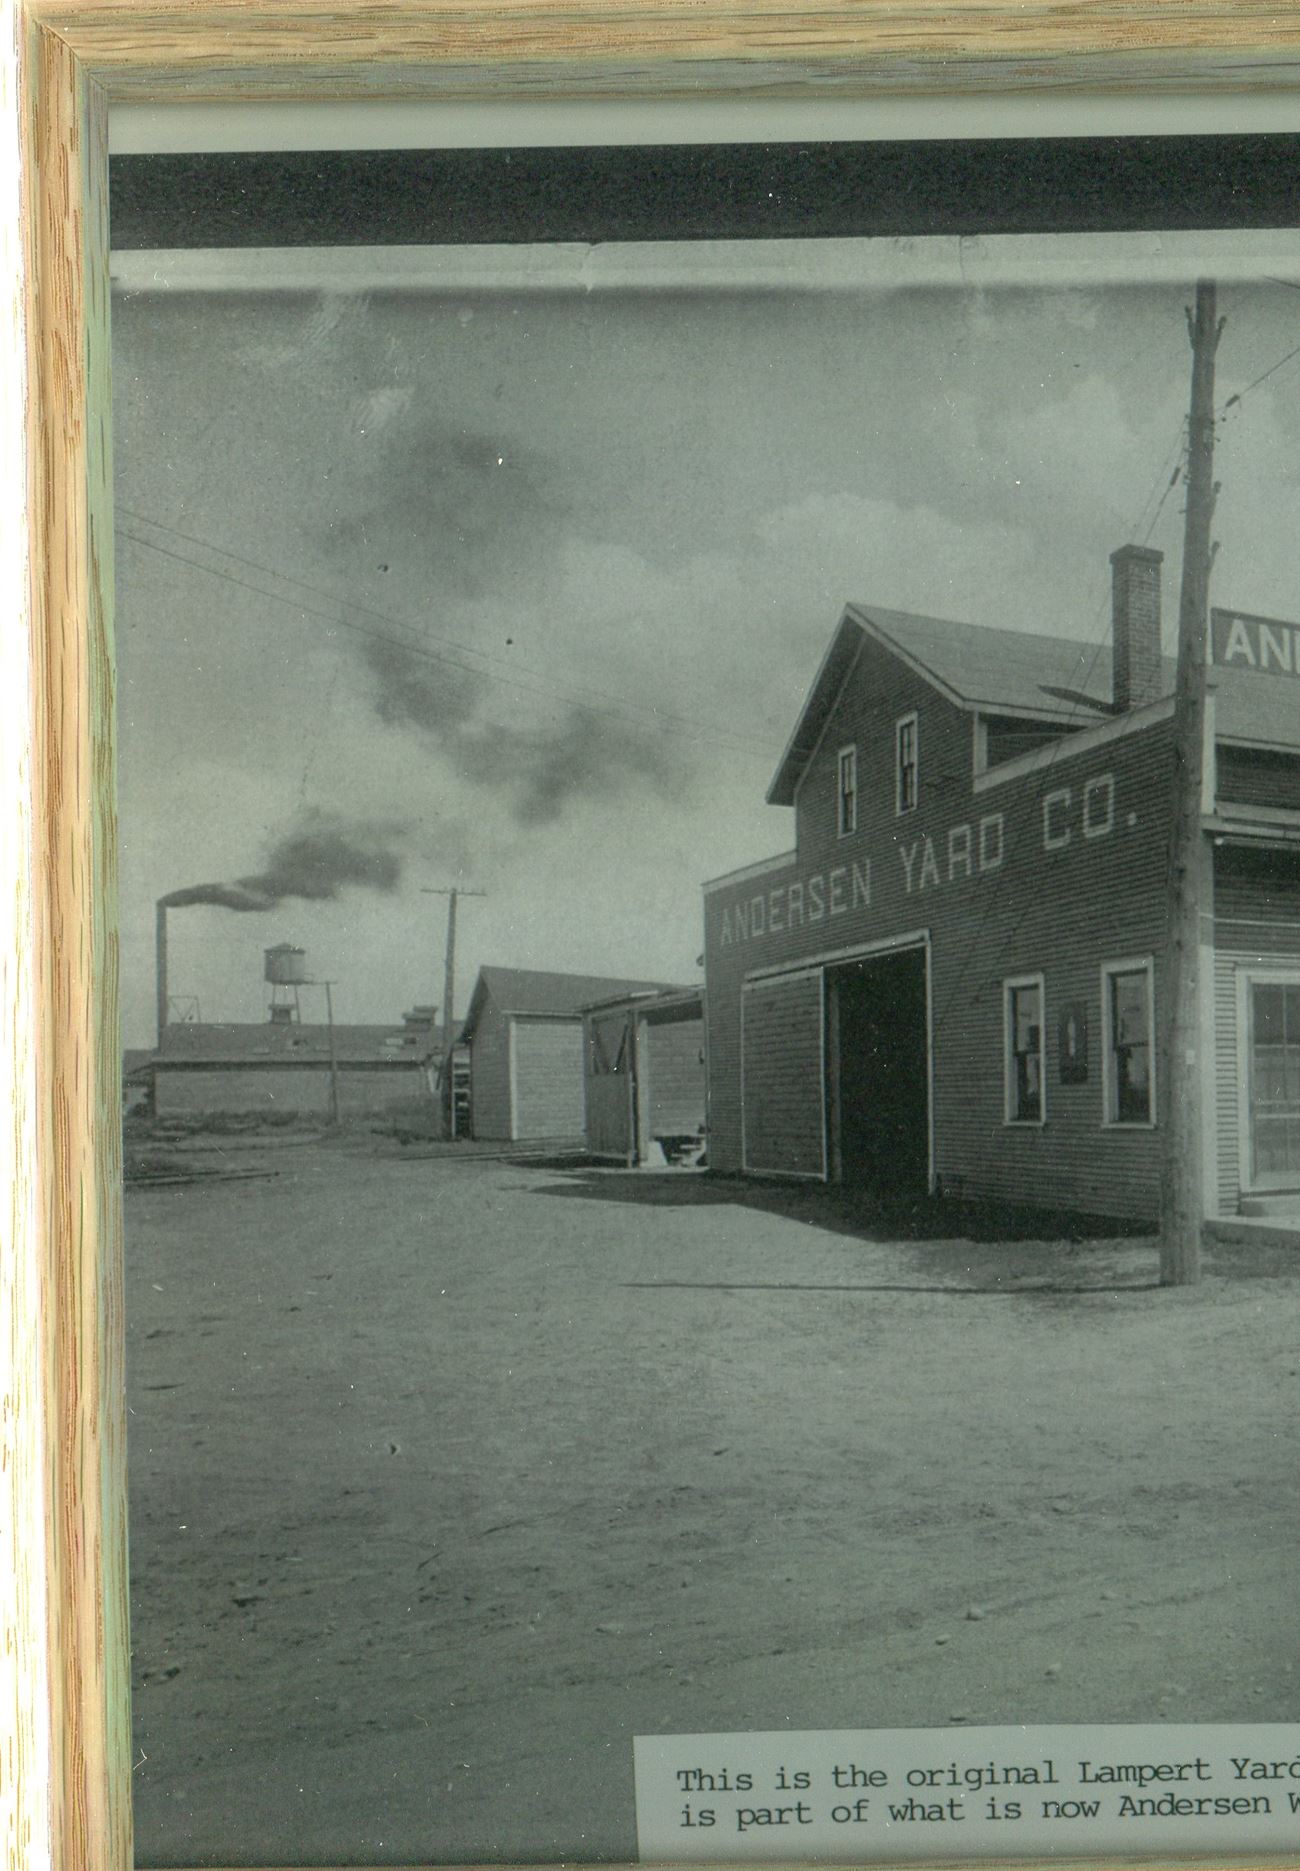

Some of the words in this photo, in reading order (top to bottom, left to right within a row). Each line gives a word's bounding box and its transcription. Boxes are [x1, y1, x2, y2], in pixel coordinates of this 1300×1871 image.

[719, 857, 872, 947] ANDERSEN
[899, 811, 1004, 893] YARD
[1042, 772, 1137, 851] CO.
